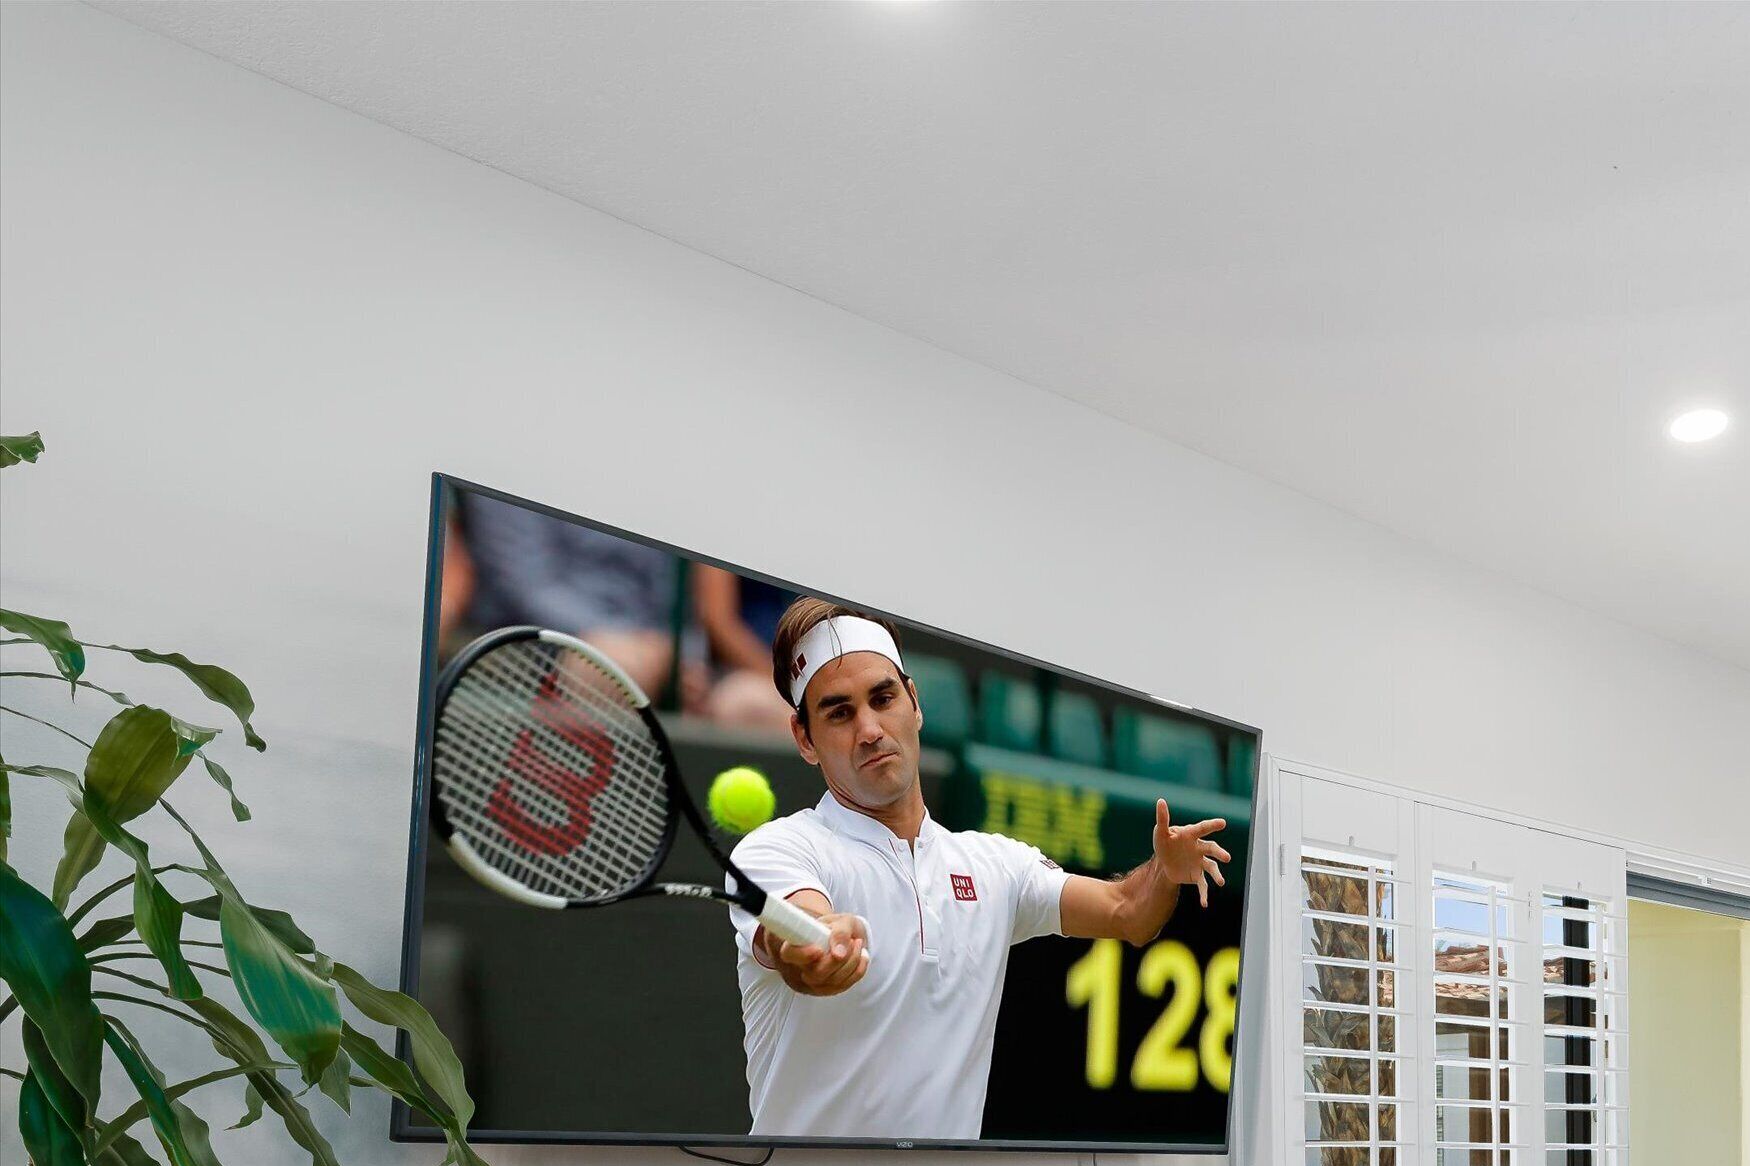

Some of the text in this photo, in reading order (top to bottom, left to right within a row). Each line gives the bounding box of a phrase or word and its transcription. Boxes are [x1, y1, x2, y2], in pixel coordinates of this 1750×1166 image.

[953, 877, 970, 888] UNI
[956, 888, 974, 899] QLO
[1065, 938, 1240, 1092] 128
